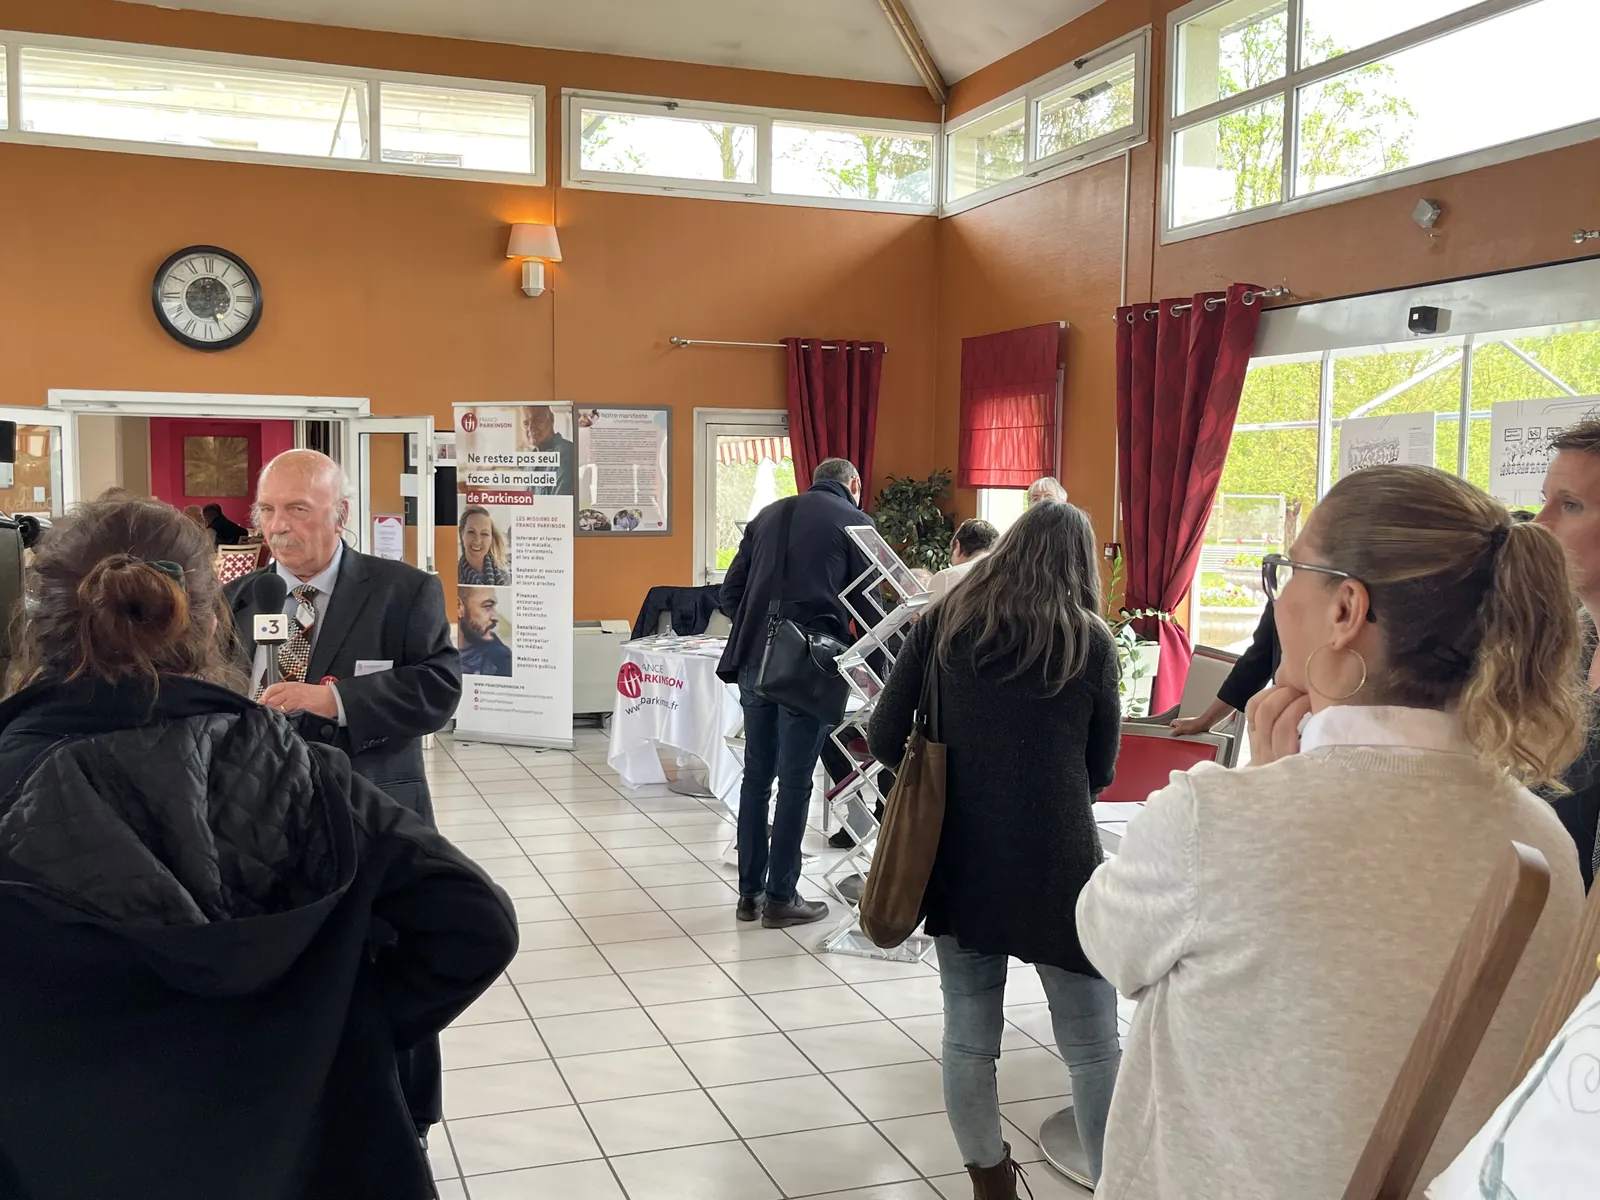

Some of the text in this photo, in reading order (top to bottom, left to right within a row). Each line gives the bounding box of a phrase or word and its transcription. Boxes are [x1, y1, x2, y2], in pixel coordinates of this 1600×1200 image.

[620, 412, 648, 420] manifeste
[467, 453, 558, 466] Ne restez pas seul
[467, 473, 555, 485] face à la maladie
[467, 493, 532, 504] de Parkinson
[268, 619, 280, 635] 3
